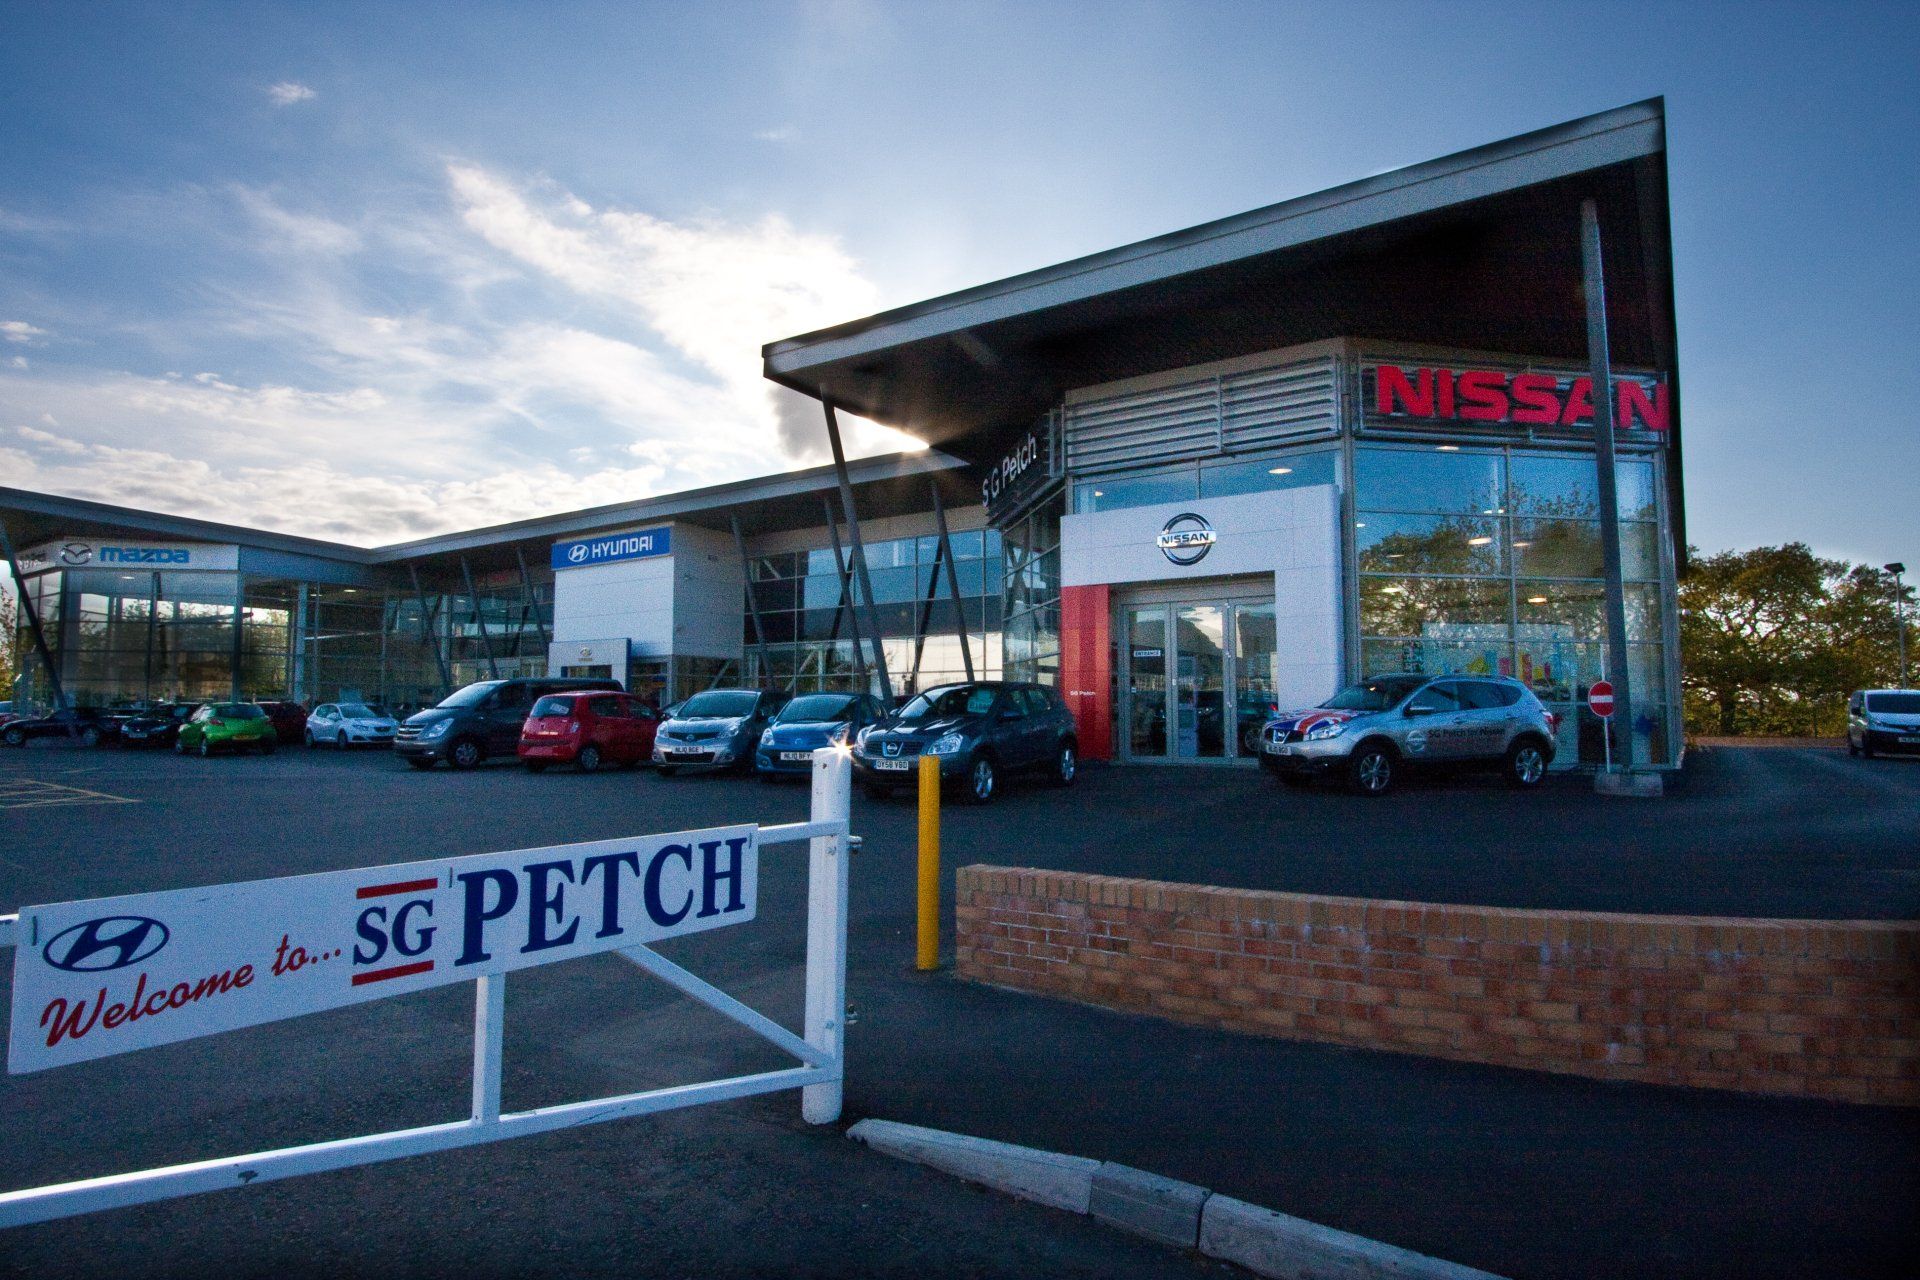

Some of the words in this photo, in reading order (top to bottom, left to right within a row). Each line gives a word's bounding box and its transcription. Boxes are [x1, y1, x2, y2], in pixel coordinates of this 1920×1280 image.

[1377, 365, 1669, 430] NISSAN
[1002, 433, 1037, 489] Petch
[100, 546, 190, 564] mazda
[591, 535, 654, 558] HYUNDAI
[1161, 532, 1210, 545] NISSAN
[353, 899, 437, 966] SG
[454, 836, 748, 966] PETCH
[39, 973, 254, 1048] Welcome
[271, 934, 341, 976] to...
